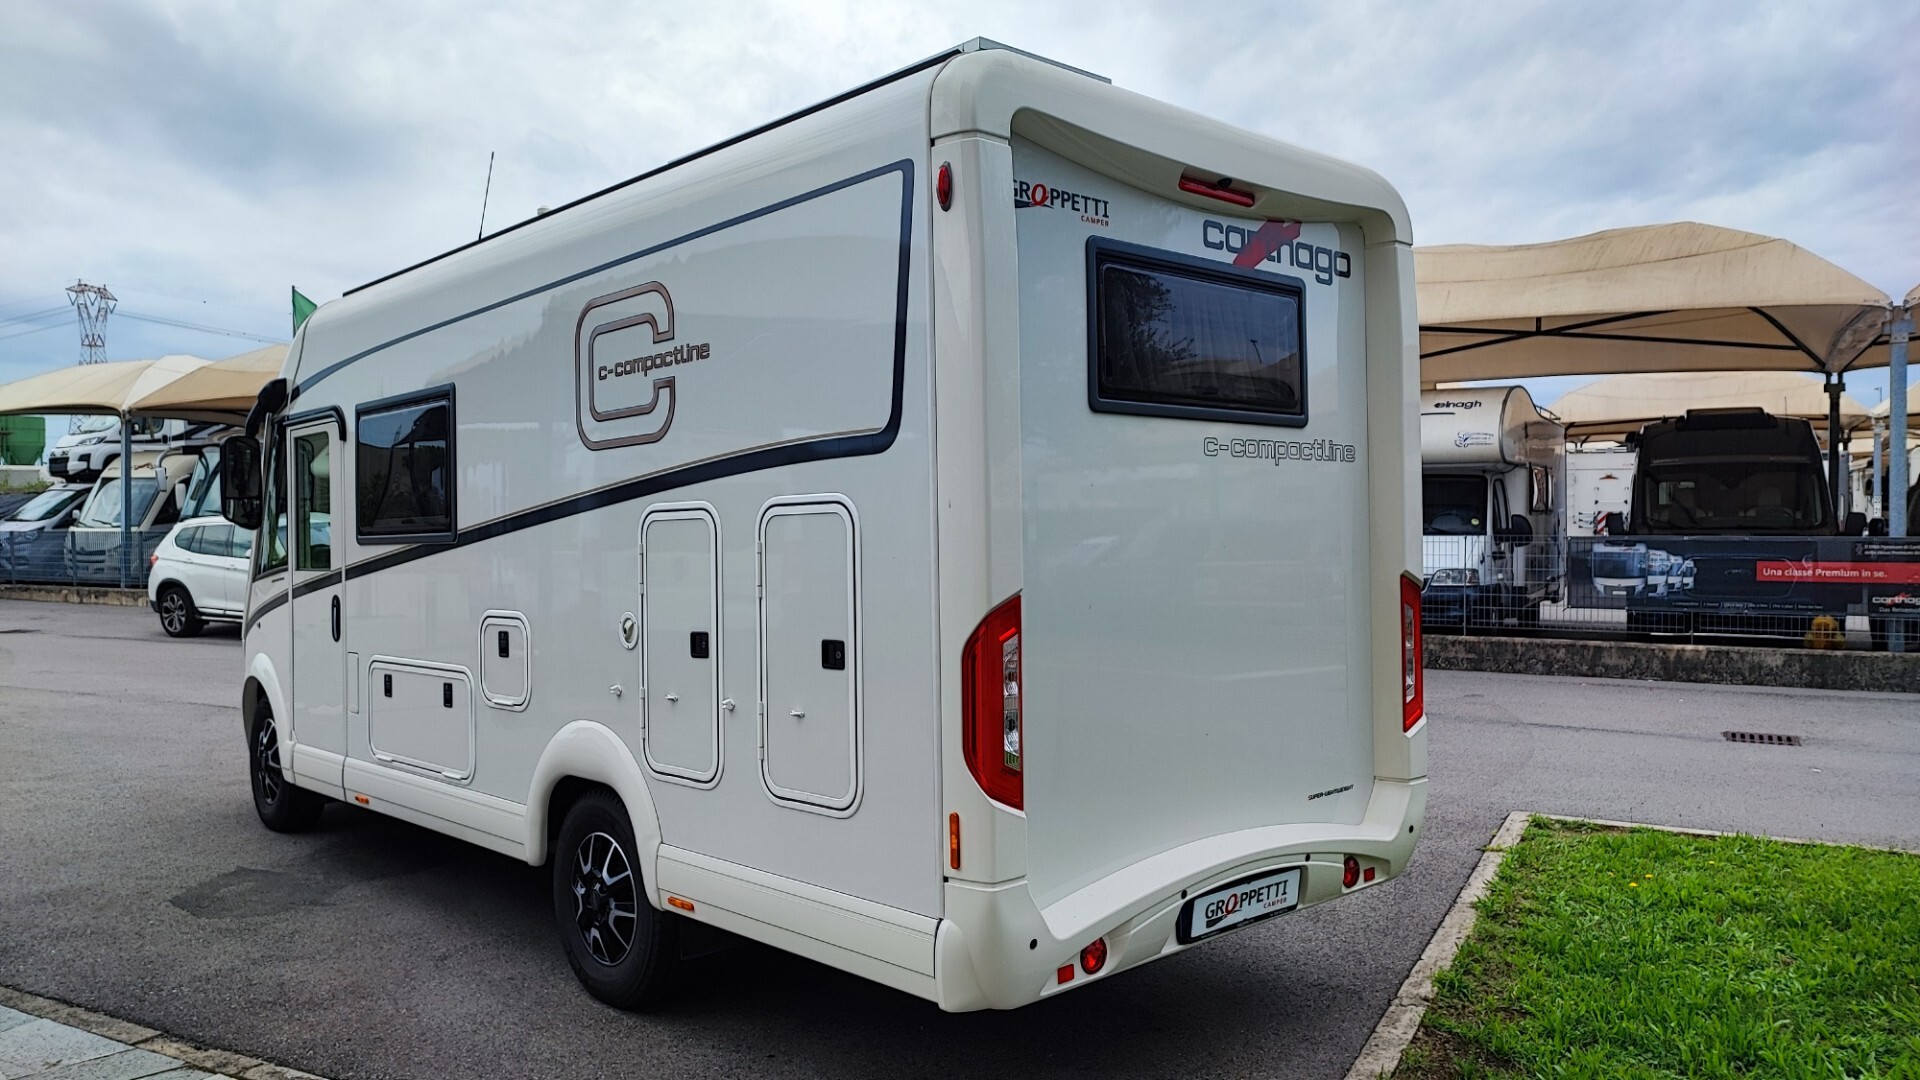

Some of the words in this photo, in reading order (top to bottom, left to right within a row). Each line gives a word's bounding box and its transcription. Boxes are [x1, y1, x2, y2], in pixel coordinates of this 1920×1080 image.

[1081, 215, 1109, 227] CAMPER
[1203, 219, 1351, 286] cahago
[598, 342, 710, 380] c-compactline
[1434, 400, 1482, 409] elnagh
[1203, 437, 1355, 466] c-compactline
[1763, 567, 1782, 576] Una
[1784, 568, 1813, 577] classe
[1815, 569, 1859, 577] Premium
[1861, 568, 1871, 577] in
[1873, 570, 1888, 578] se.
[1205, 880, 1289, 920] GROPPETTI
[1263, 897, 1287, 909] CAMPER
